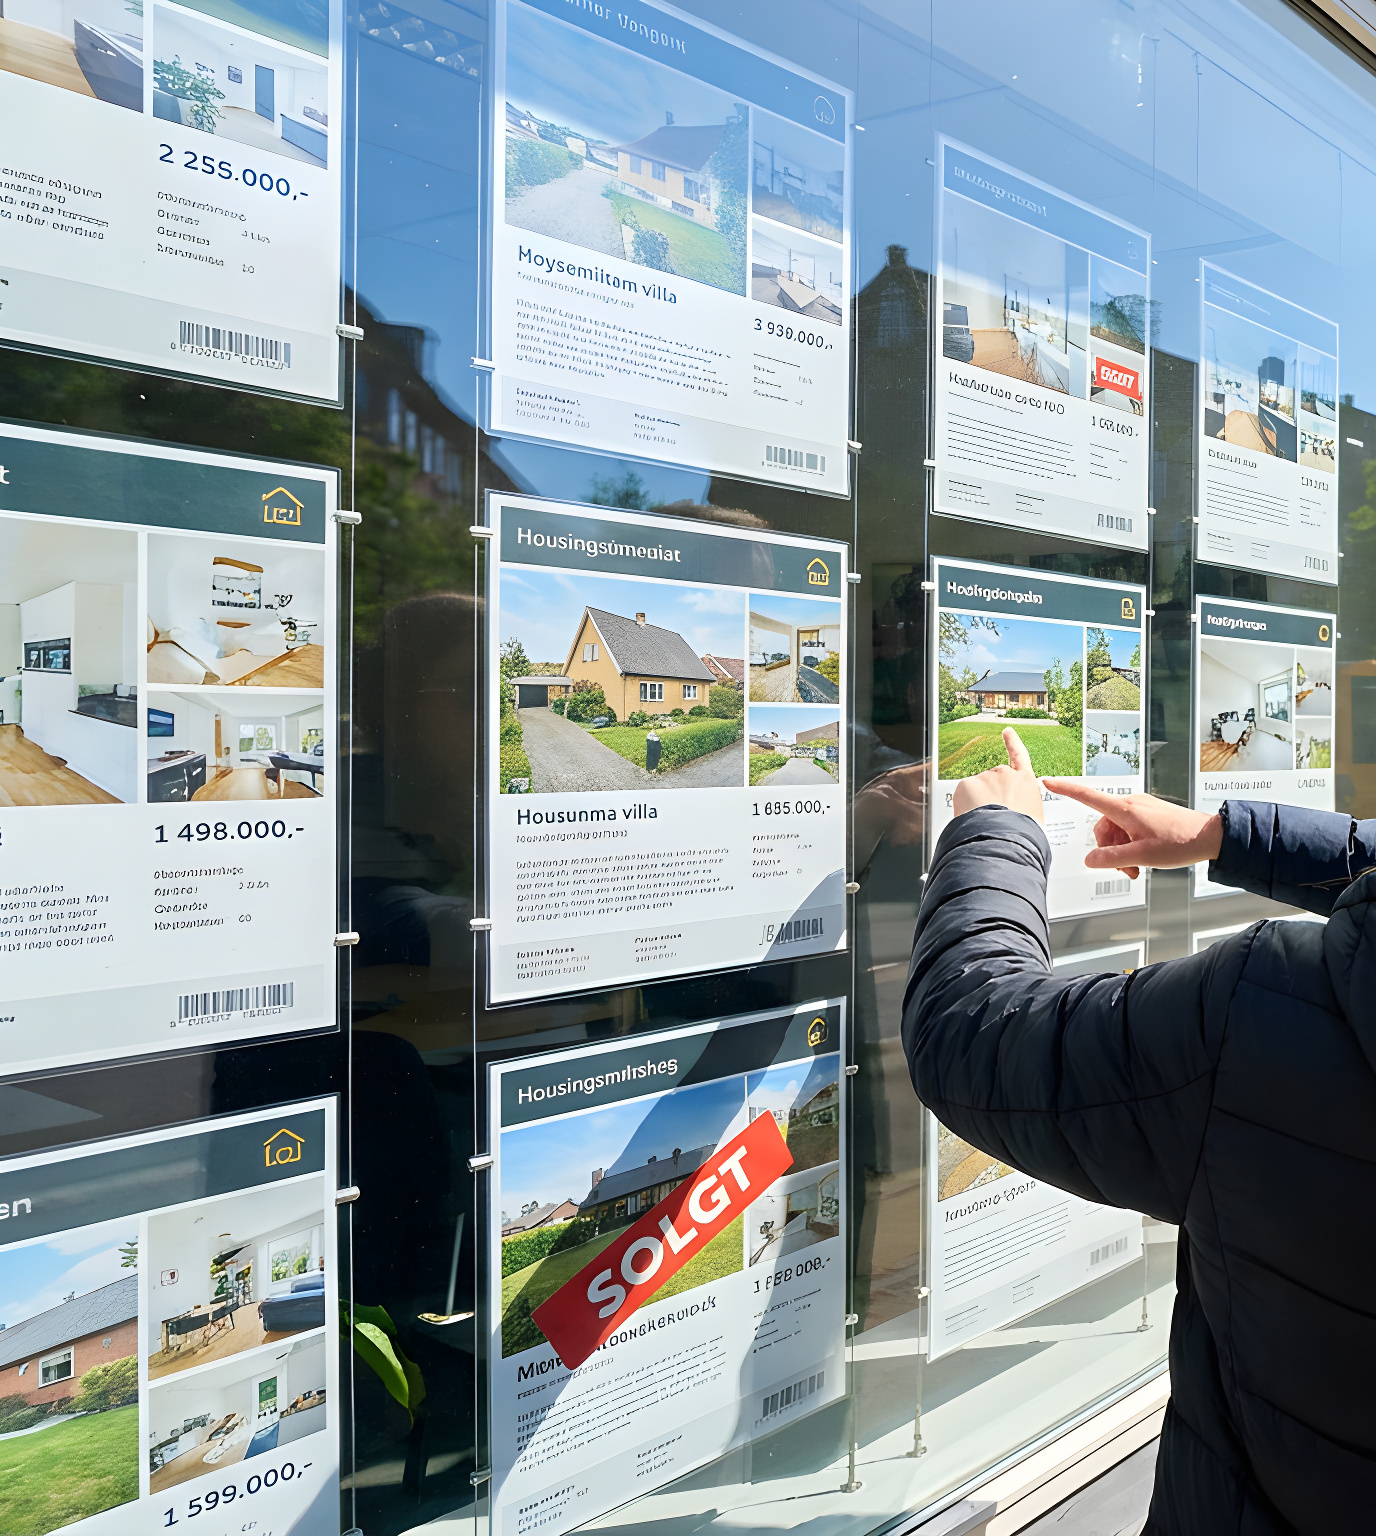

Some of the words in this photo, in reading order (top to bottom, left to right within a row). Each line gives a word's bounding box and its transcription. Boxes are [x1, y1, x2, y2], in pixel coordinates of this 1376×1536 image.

[159, 143, 175, 164] 2
[642, 283, 677, 304] villa
[753, 318, 762, 331] 3
[622, 803, 658, 820] villa
[752, 802, 761, 816] 1
[155, 825, 169, 843] 1
[177, 820, 304, 842] 498.000,-
[587, 1145, 751, 1319] SOLGT
[163, 1507, 179, 1528] 1
[187, 1462, 313, 1518] 599.000,-
